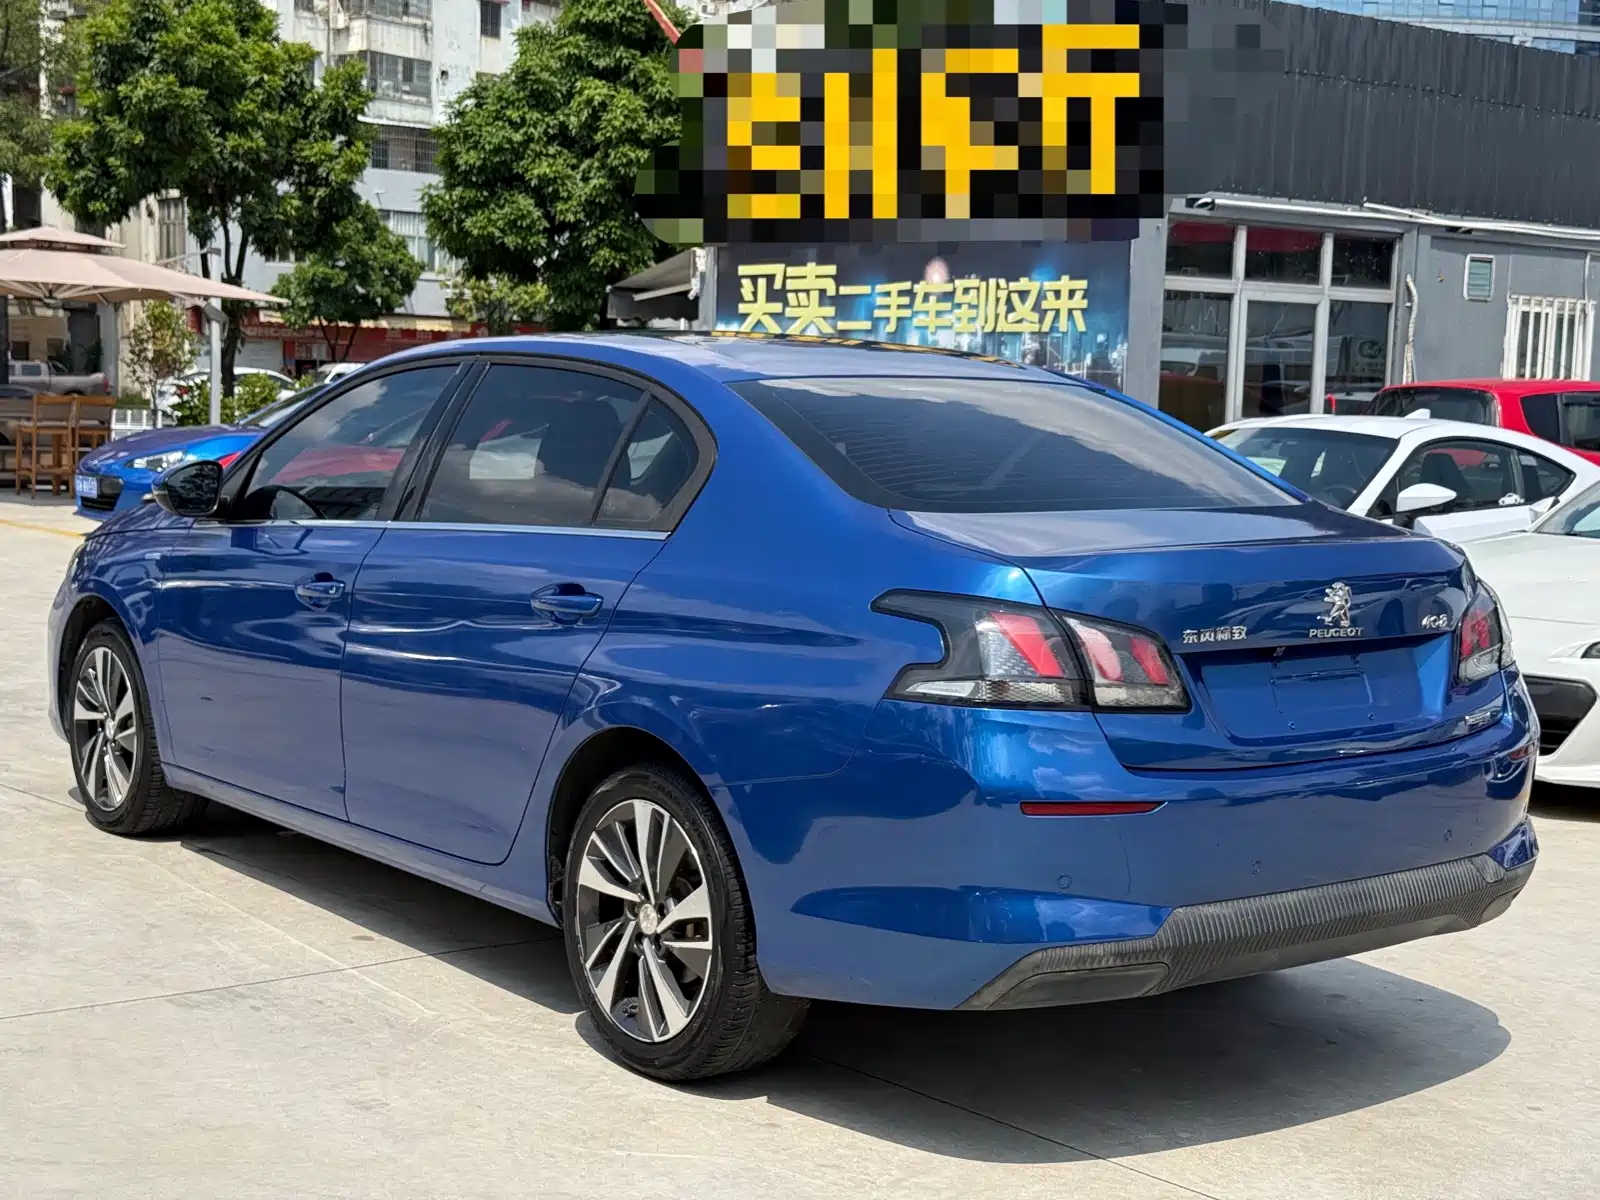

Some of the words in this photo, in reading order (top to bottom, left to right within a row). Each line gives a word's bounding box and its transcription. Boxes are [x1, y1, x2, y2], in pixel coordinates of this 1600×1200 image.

[737, 262, 1089, 334] 买卖二手车到这来
[1421, 613, 1448, 629] 408
[1182, 625, 1248, 644] 东风标致
[1308, 626, 1364, 638] PEUGEOT
